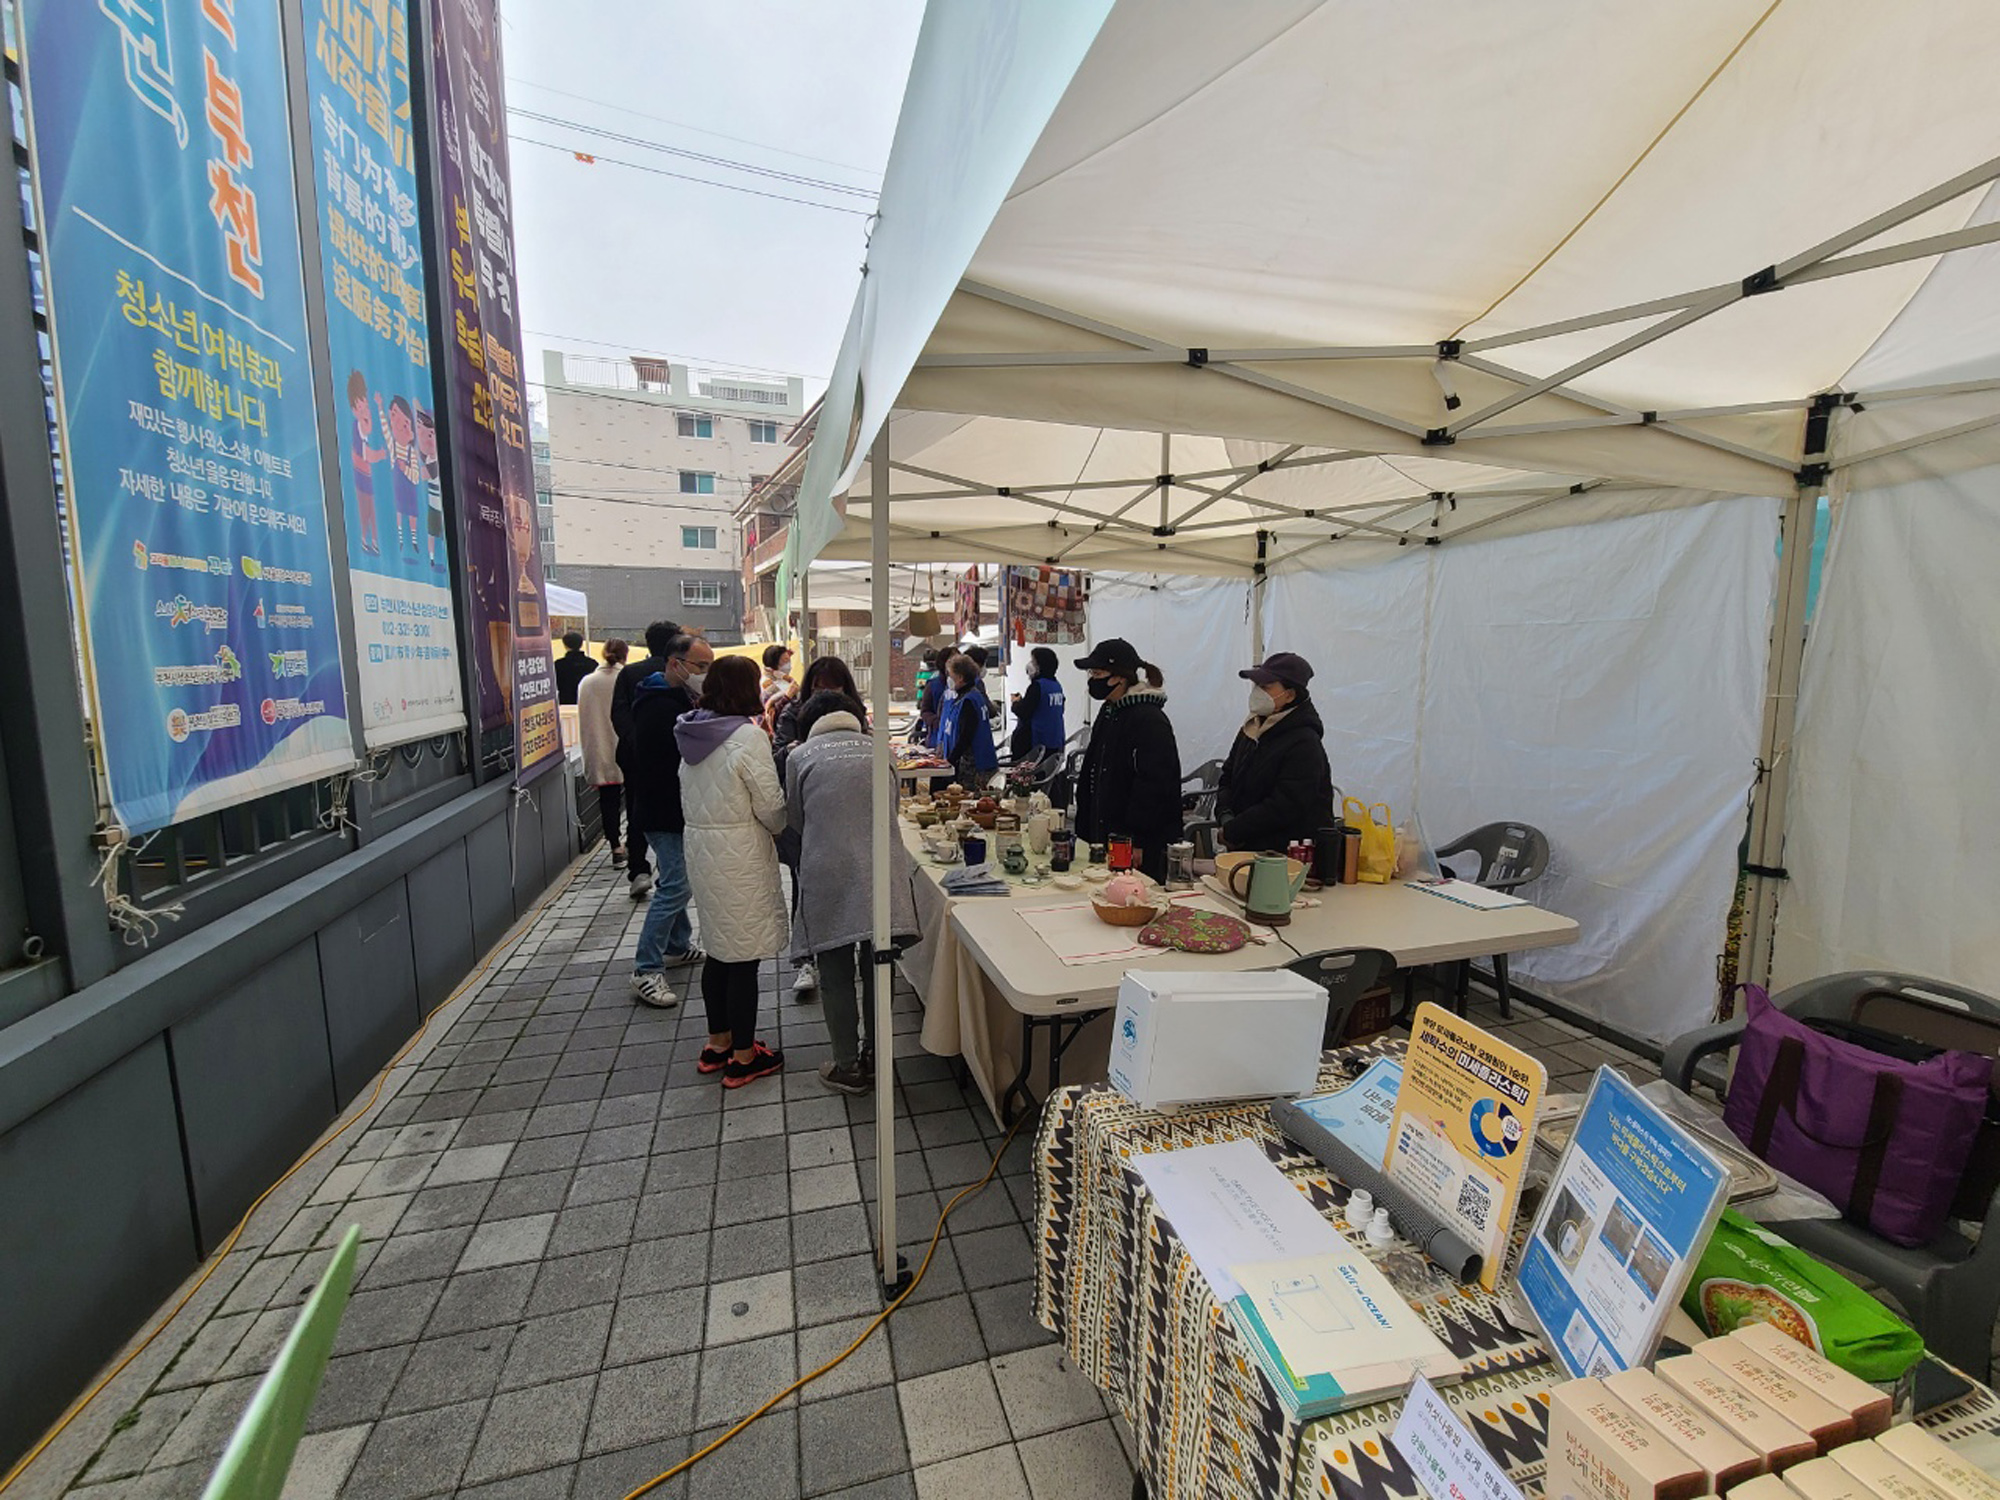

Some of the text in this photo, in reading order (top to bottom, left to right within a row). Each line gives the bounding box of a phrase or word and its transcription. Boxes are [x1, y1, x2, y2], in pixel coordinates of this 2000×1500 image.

[115, 269, 283, 399] 청소년 여러분과
[127, 400, 177, 439] 재밌는
[152, 348, 269, 438] 함께합니다!
[118, 468, 166, 502] 자세한
[168, 480, 211, 514] 내용은
[1456, 1050, 1530, 1106] 미세플라스틱!
[1337, 1264, 1358, 1286] SAVE
[1361, 1295, 1393, 1329] OCEAN!
[1463, 1448, 1482, 1473] 쉽게
